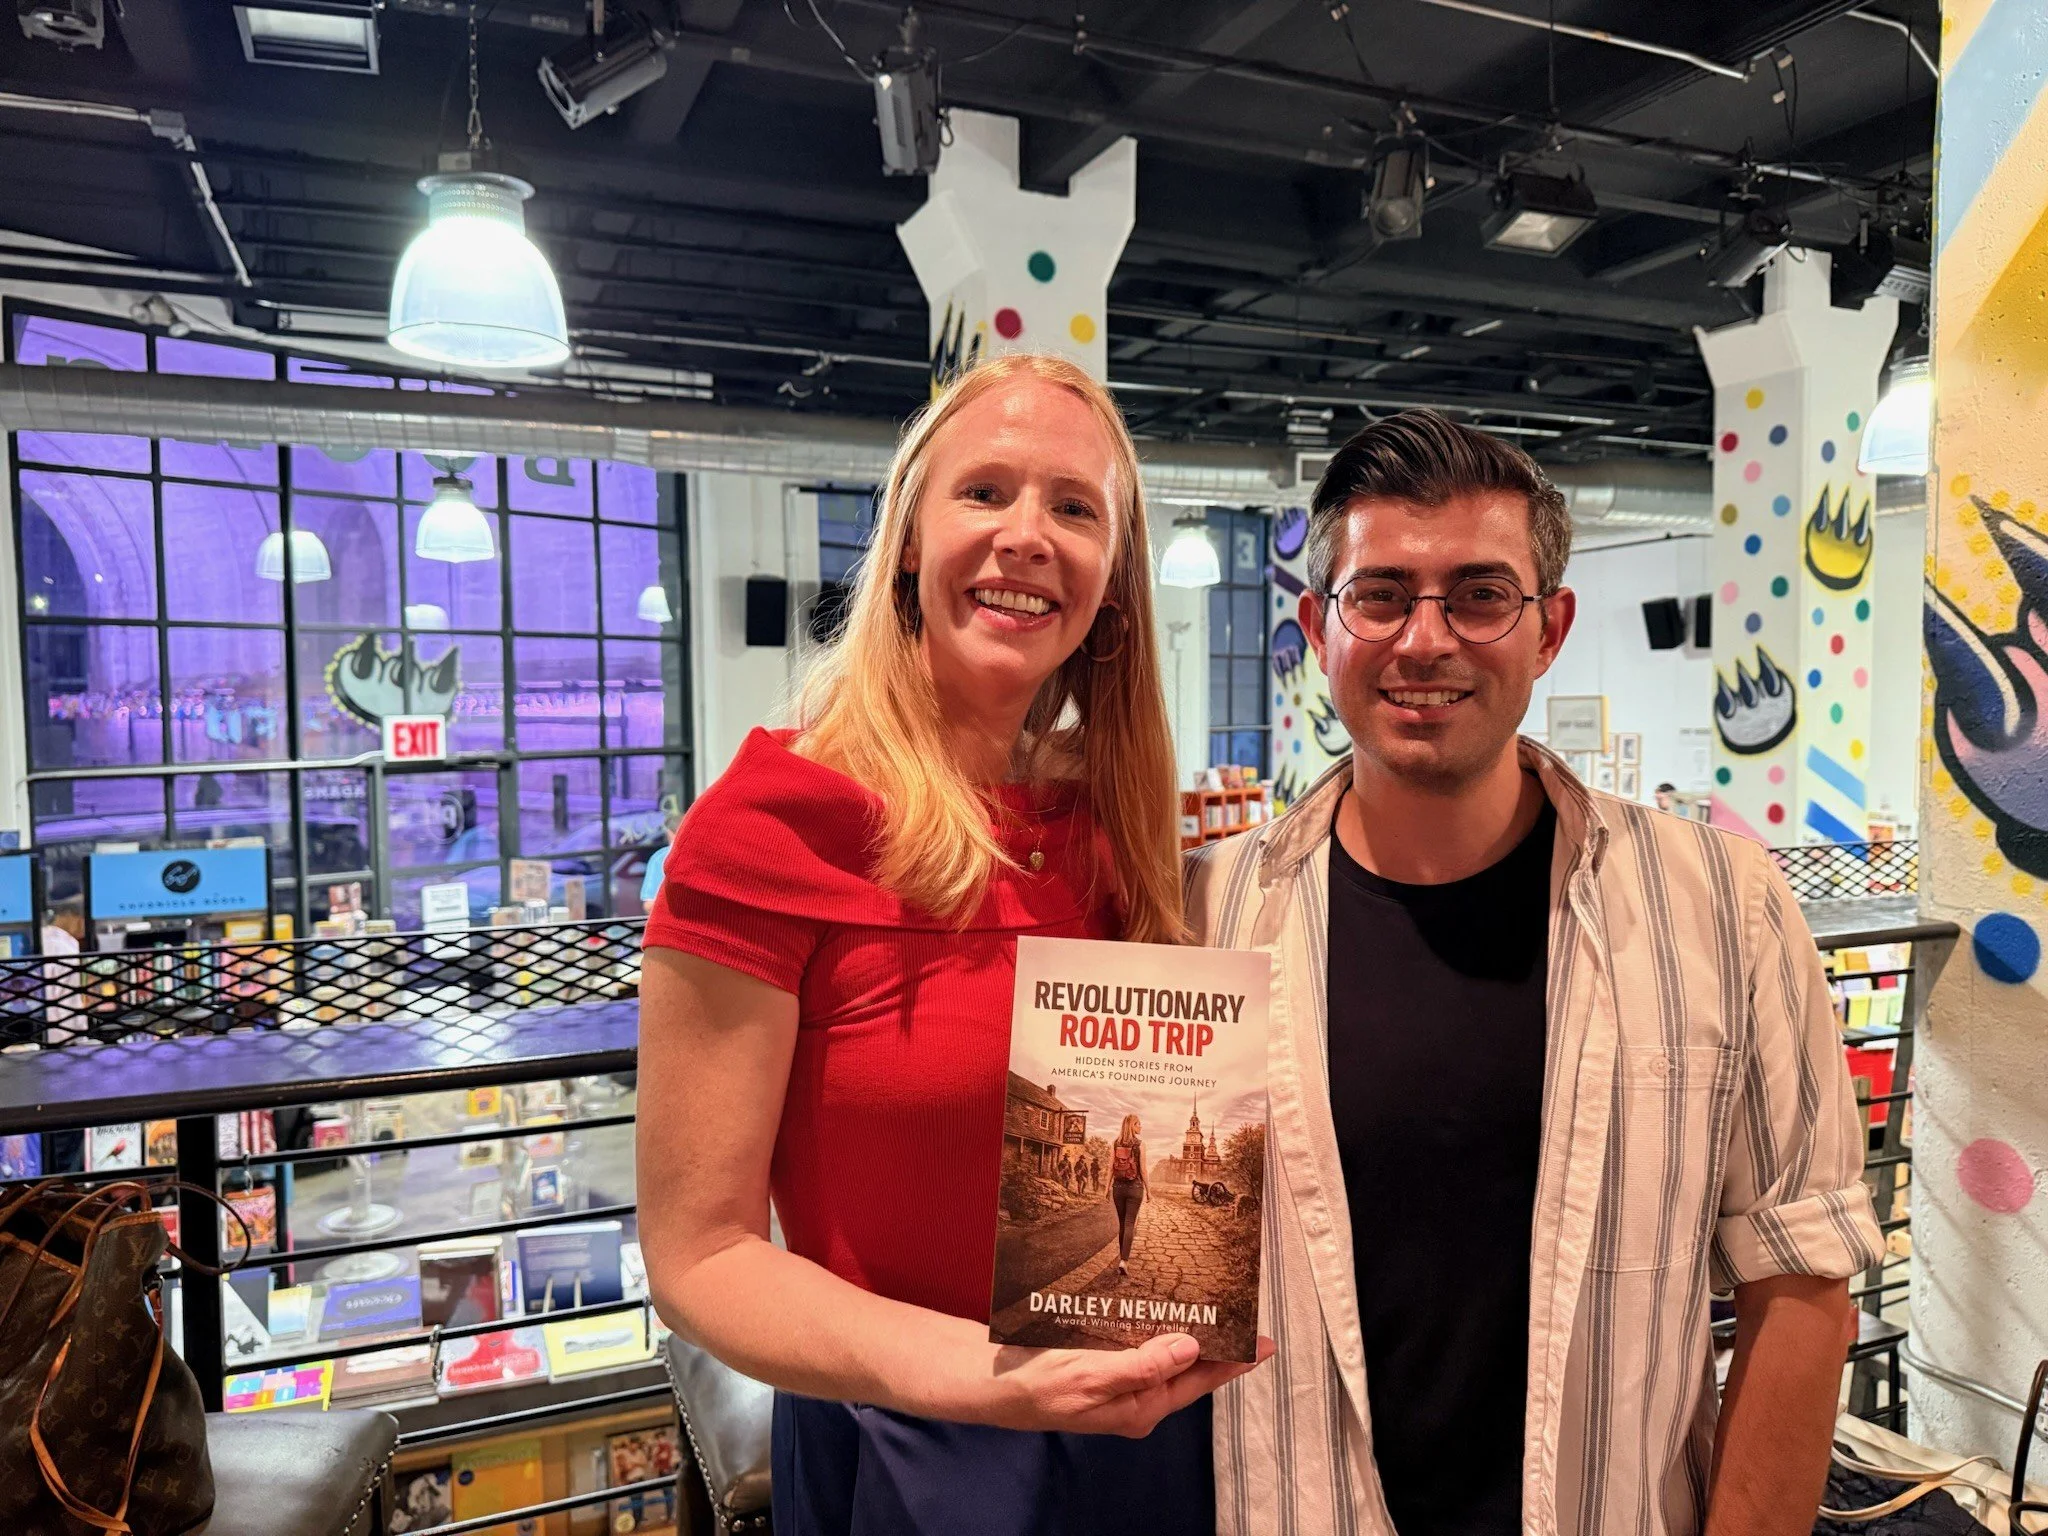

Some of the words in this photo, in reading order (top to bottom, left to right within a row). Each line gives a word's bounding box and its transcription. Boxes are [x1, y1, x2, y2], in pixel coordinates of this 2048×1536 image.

[393, 722, 440, 757] EXIT
[1034, 980, 1245, 1023] REVOLUTIONARY
[1060, 1014, 1141, 1052] ROAD
[1148, 1020, 1214, 1057] TRIP
[1051, 1067, 1105, 1079] AMERICA'S
[1108, 1071, 1165, 1084] FOUNDING
[1168, 1077, 1217, 1088] JOURNEY
[1075, 1056, 1114, 1067] HIDDEN
[1118, 1059, 1160, 1071] STORIES
[1164, 1062, 1193, 1073] FROM
[1029, 1292, 1114, 1317] DARLEY
[1119, 1298, 1217, 1326] NEWMAN
[1054, 1315, 1132, 1331] Award-Winning
[1135, 1320, 1190, 1334] Storyteller
